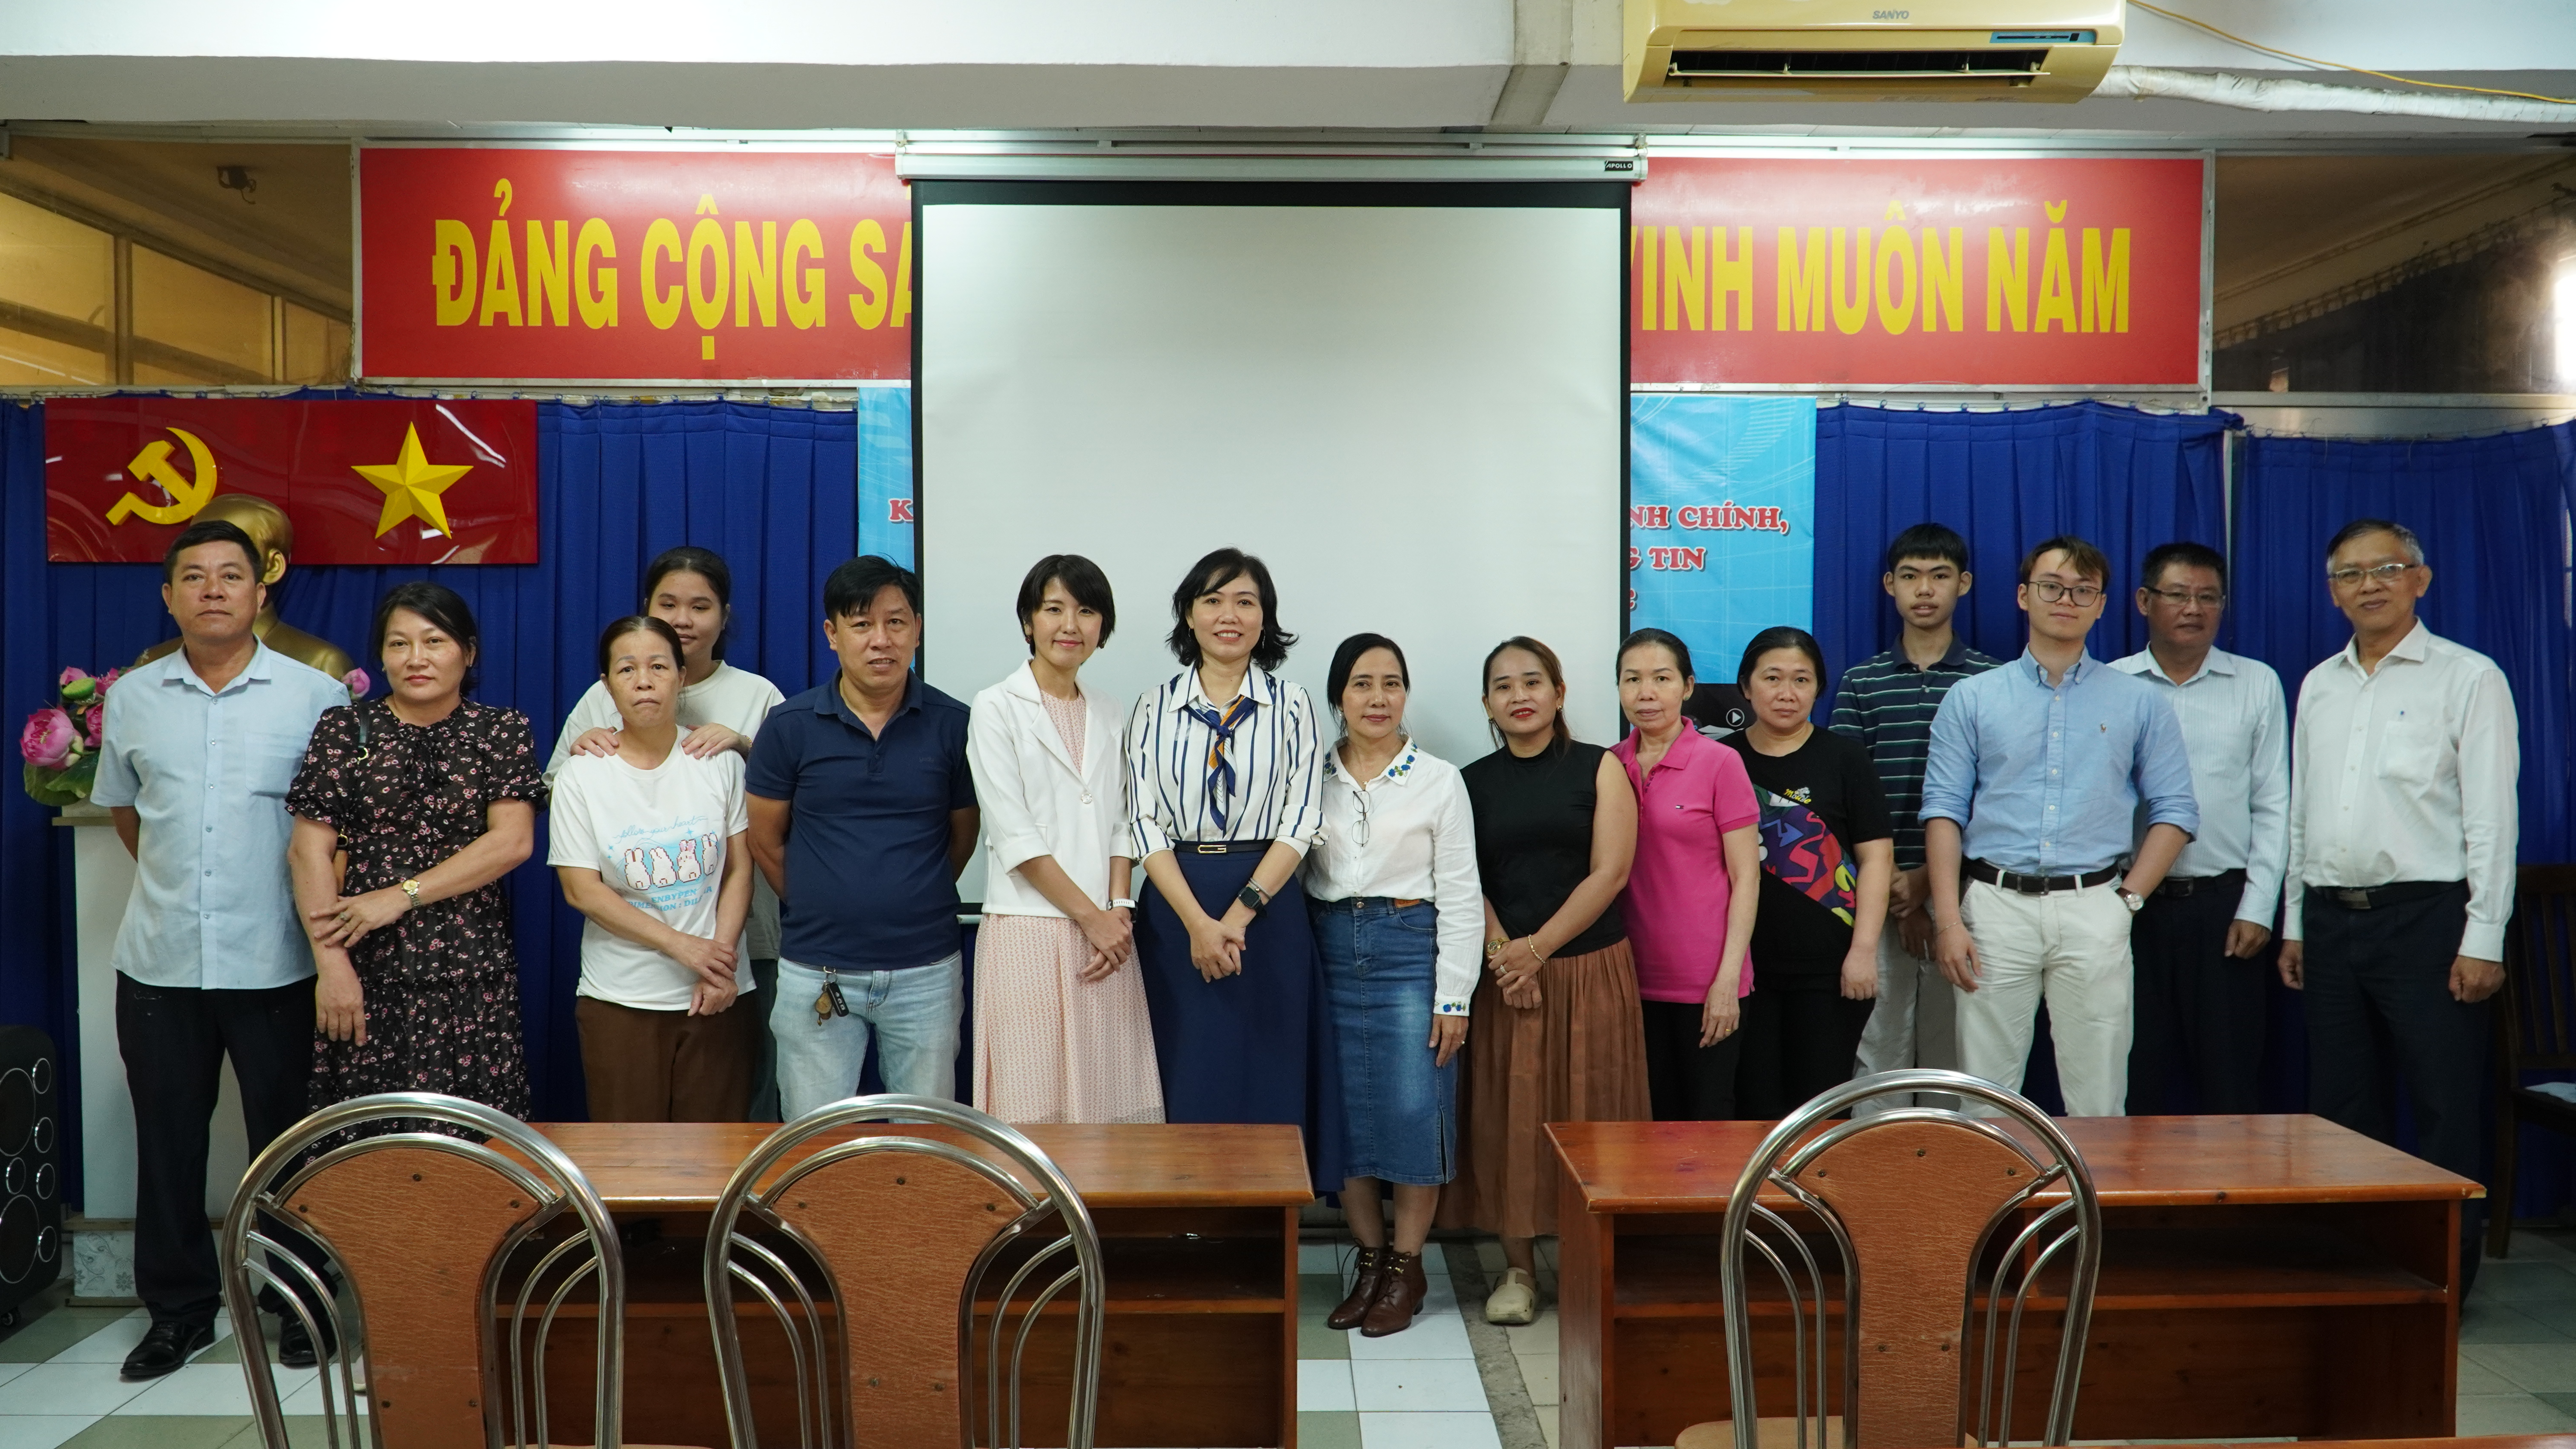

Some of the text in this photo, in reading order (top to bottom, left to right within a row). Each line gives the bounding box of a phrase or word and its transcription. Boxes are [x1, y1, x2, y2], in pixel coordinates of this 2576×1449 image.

[1872, 10, 1909, 19] SANYO
[432, 178, 617, 330] ĐẢNG
[641, 194, 826, 360] CỘNG
[1631, 225, 1753, 330] INH
[1777, 200, 1963, 335] MUÔN
[1987, 200, 2130, 333] NĂM
[1630, 505, 1670, 528] NH
[1677, 500, 1789, 535] CHÍNH,
[1648, 546, 1706, 570] TIN
